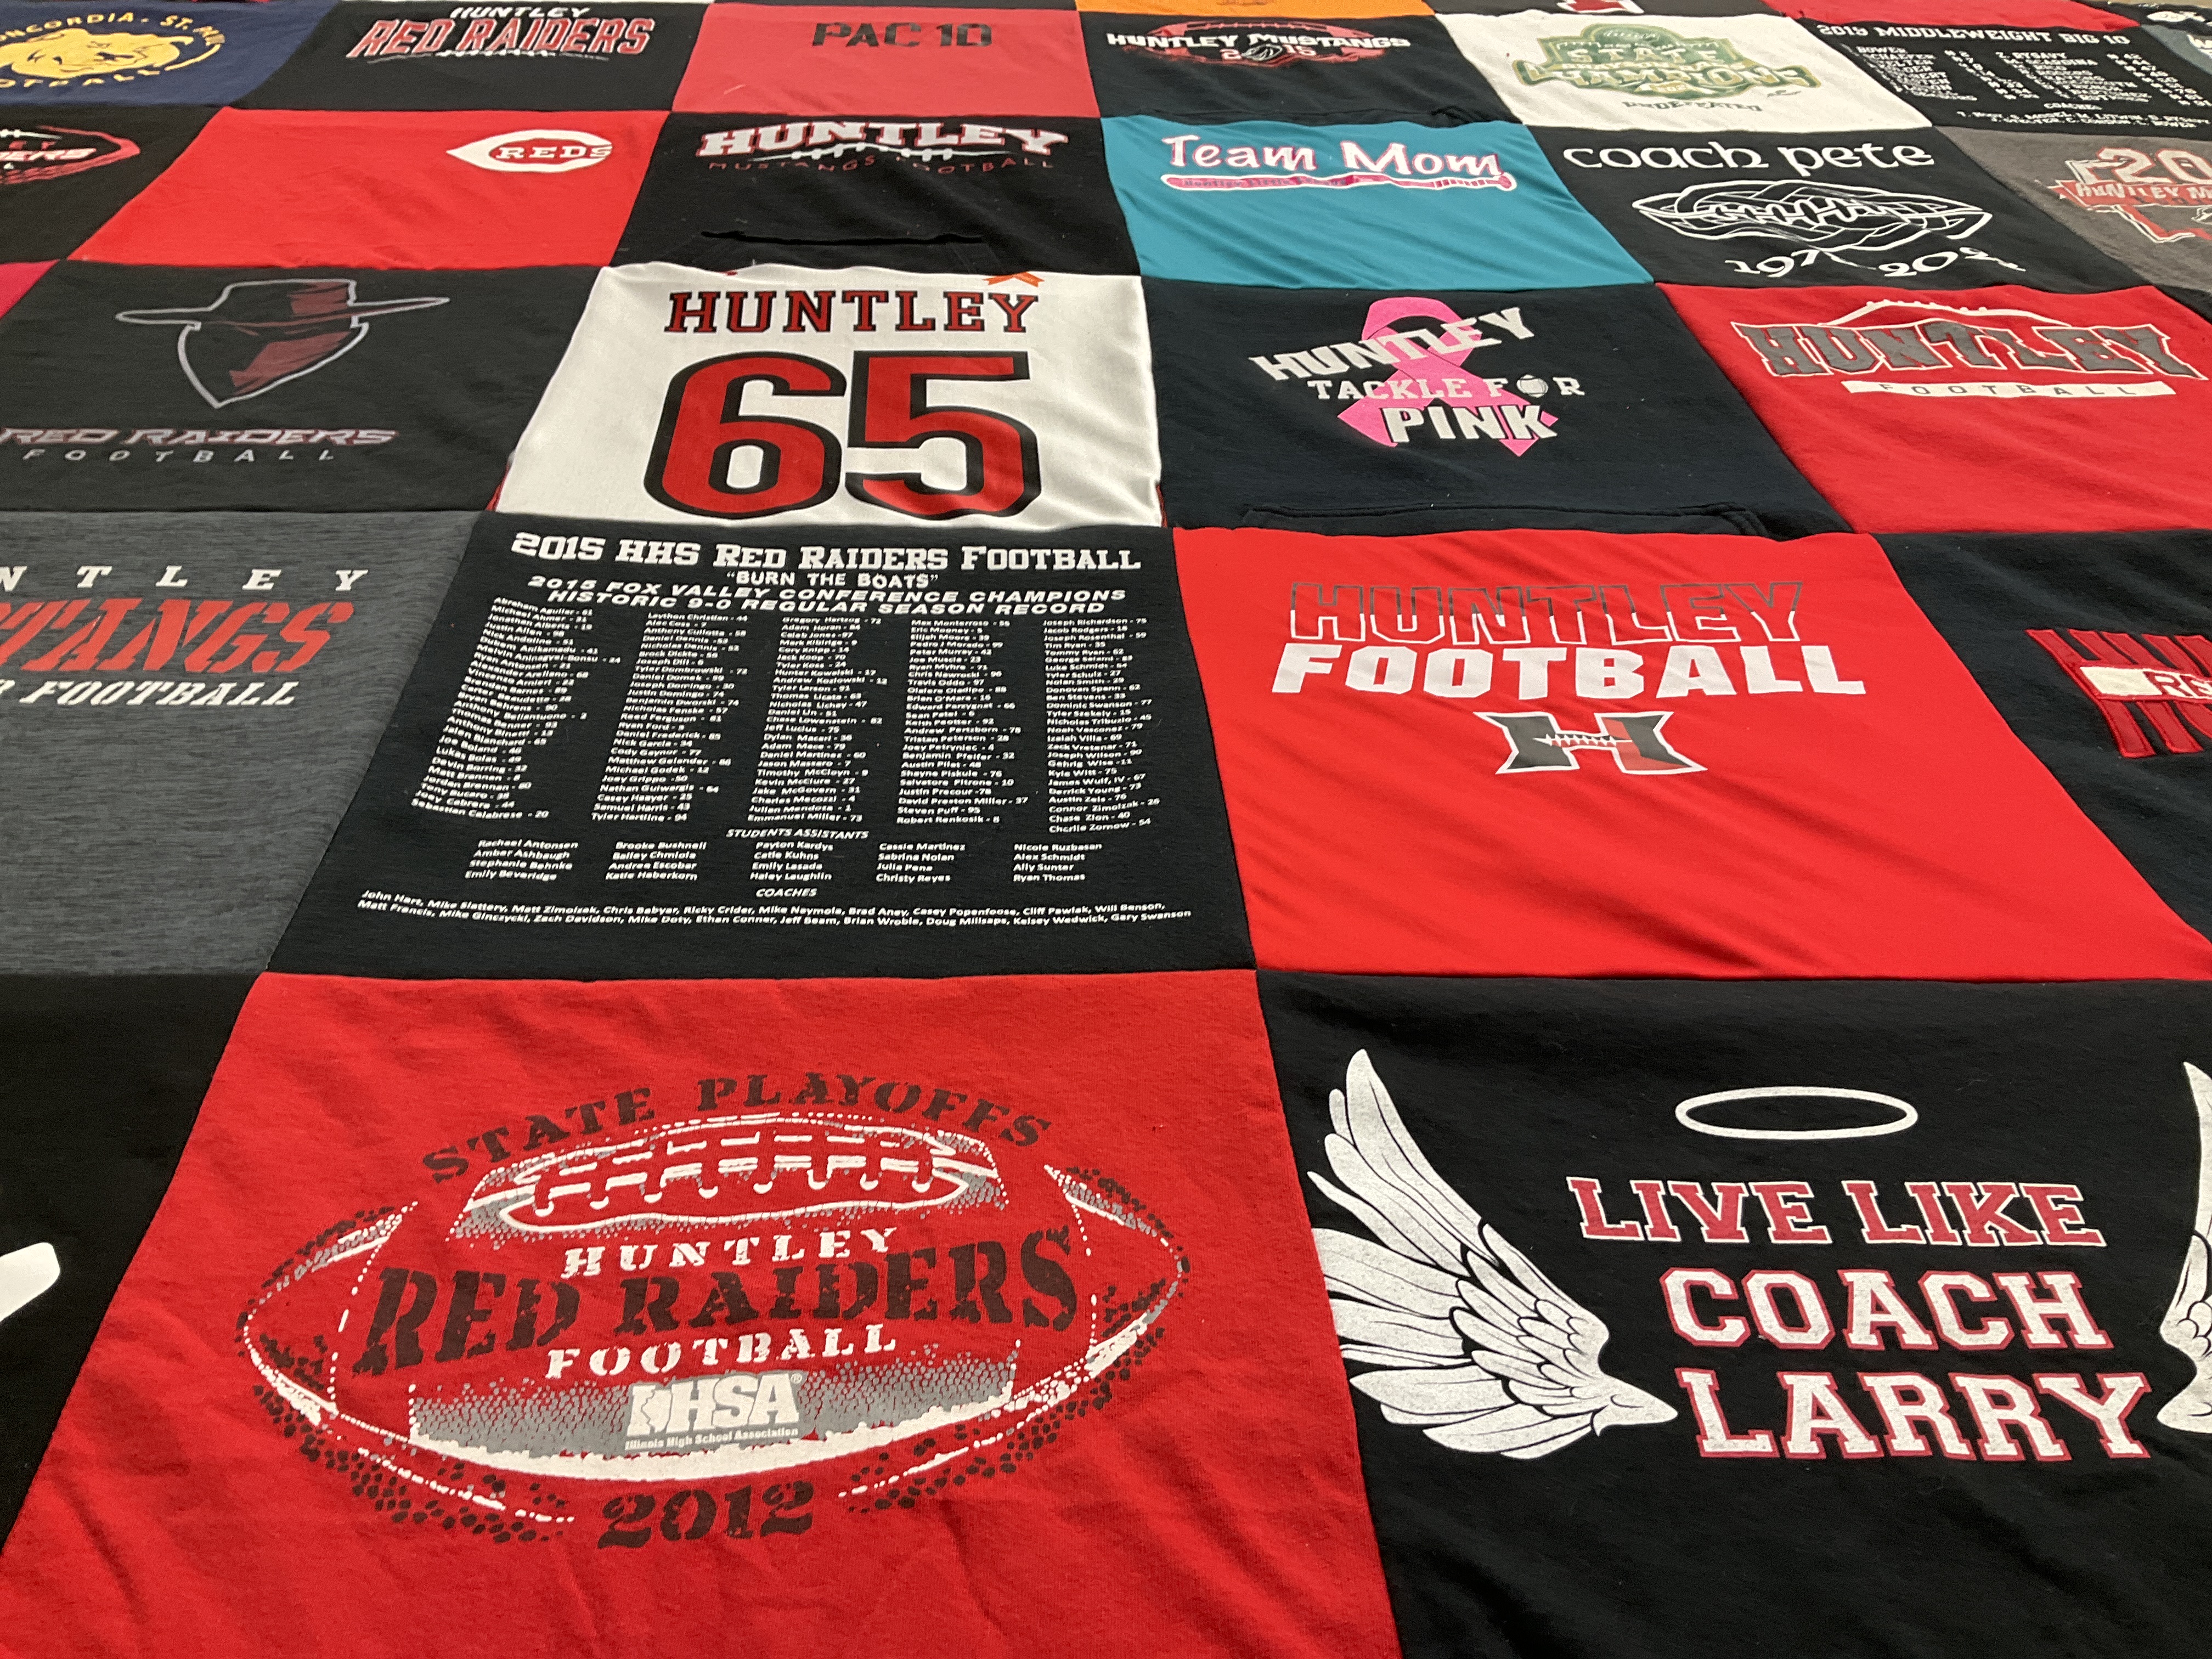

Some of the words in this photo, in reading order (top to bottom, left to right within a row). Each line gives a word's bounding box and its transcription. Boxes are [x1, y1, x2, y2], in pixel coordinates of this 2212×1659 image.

[450, 7, 591, 19] HUNTLEY
[346, 19, 455, 58] RED
[457, 17, 656, 54] RAIDERS
[812, 22, 921, 47] PAC
[940, 22, 991, 47] 10
[1107, 33, 1239, 48] HUNTLEY
[1249, 33, 1411, 48] MUSTANGS
[1874, 27, 2052, 42] MIDDLEWEIGHT
[2058, 33, 2100, 44] BIG
[2103, 35, 2131, 44] 10
[1567, 47, 1718, 65] STATE
[495, 146, 613, 159] REDS
[696, 121, 1068, 157] HUNTLEY
[1161, 135, 1318, 171] Team
[1340, 140, 1504, 177] Mom
[896, 155, 1054, 174] OOTBALL
[1563, 141, 1769, 168] coach
[1778, 142, 1935, 177] pete
[663, 290, 1040, 334] HUNTLEY
[1248, 307, 1535, 381] HUNTLEY
[1730, 317, 2210, 381] HUNTLEY
[1307, 378, 1472, 400] TACKLE
[1878, 383, 2137, 396] FOOTBALL
[0, 427, 120, 445] RED
[122, 427, 399, 447] RAIDERS
[643, 350, 1043, 521] 65
[1381, 404, 1559, 444] PINK
[22, 449, 335, 463] FOOTBALL
[511, 532, 606, 561] 2015
[615, 539, 701, 566] HHS
[528, 575, 597, 591] 2015
[606, 580, 662, 596] FOX
[672, 584, 771, 599] VALLEY
[779, 588, 959, 603] CONFERENCE
[969, 589, 1127, 603] CHAMPIONS
[807, 573, 845, 586] THE
[548, 589, 678, 609] HISTORIC
[687, 598, 731, 610] 9-0
[741, 599, 868, 613] REGULAR
[878, 602, 985, 616] SEASON
[994, 602, 1106, 616] RECORD
[1290, 581, 1803, 645] HUNTLEY
[0, 597, 354, 673] TANGS
[1272, 642, 1866, 700] FOOTBALL
[19, 680, 300, 706] FOOTBALL
[726, 828, 792, 838] STUDENTS
[794, 828, 870, 839] ASSISTANTS
[756, 888, 817, 898] COACHES
[423, 1086, 657, 1184] STATE
[696, 1073, 1052, 1149] PLAYOFFS
[1566, 1176, 1833, 1244] LIVE
[1842, 1180, 2107, 1247] LIKE
[561, 1227, 899, 1280] HUNTLEY
[352, 1263, 581, 1377] RED
[618, 1224, 1079, 1337] RAIDERS
[1658, 1266, 2115, 1351] COACH
[545, 1323, 898, 1380] FOOTBALL
[1673, 1367, 2152, 1462] LARRY
[624, 1438, 664, 1451] Illinois
[666, 1437, 693, 1448] High
[695, 1431, 732, 1444] School
[734, 1427, 799, 1440] Association
[596, 1480, 815, 1550] 2012
